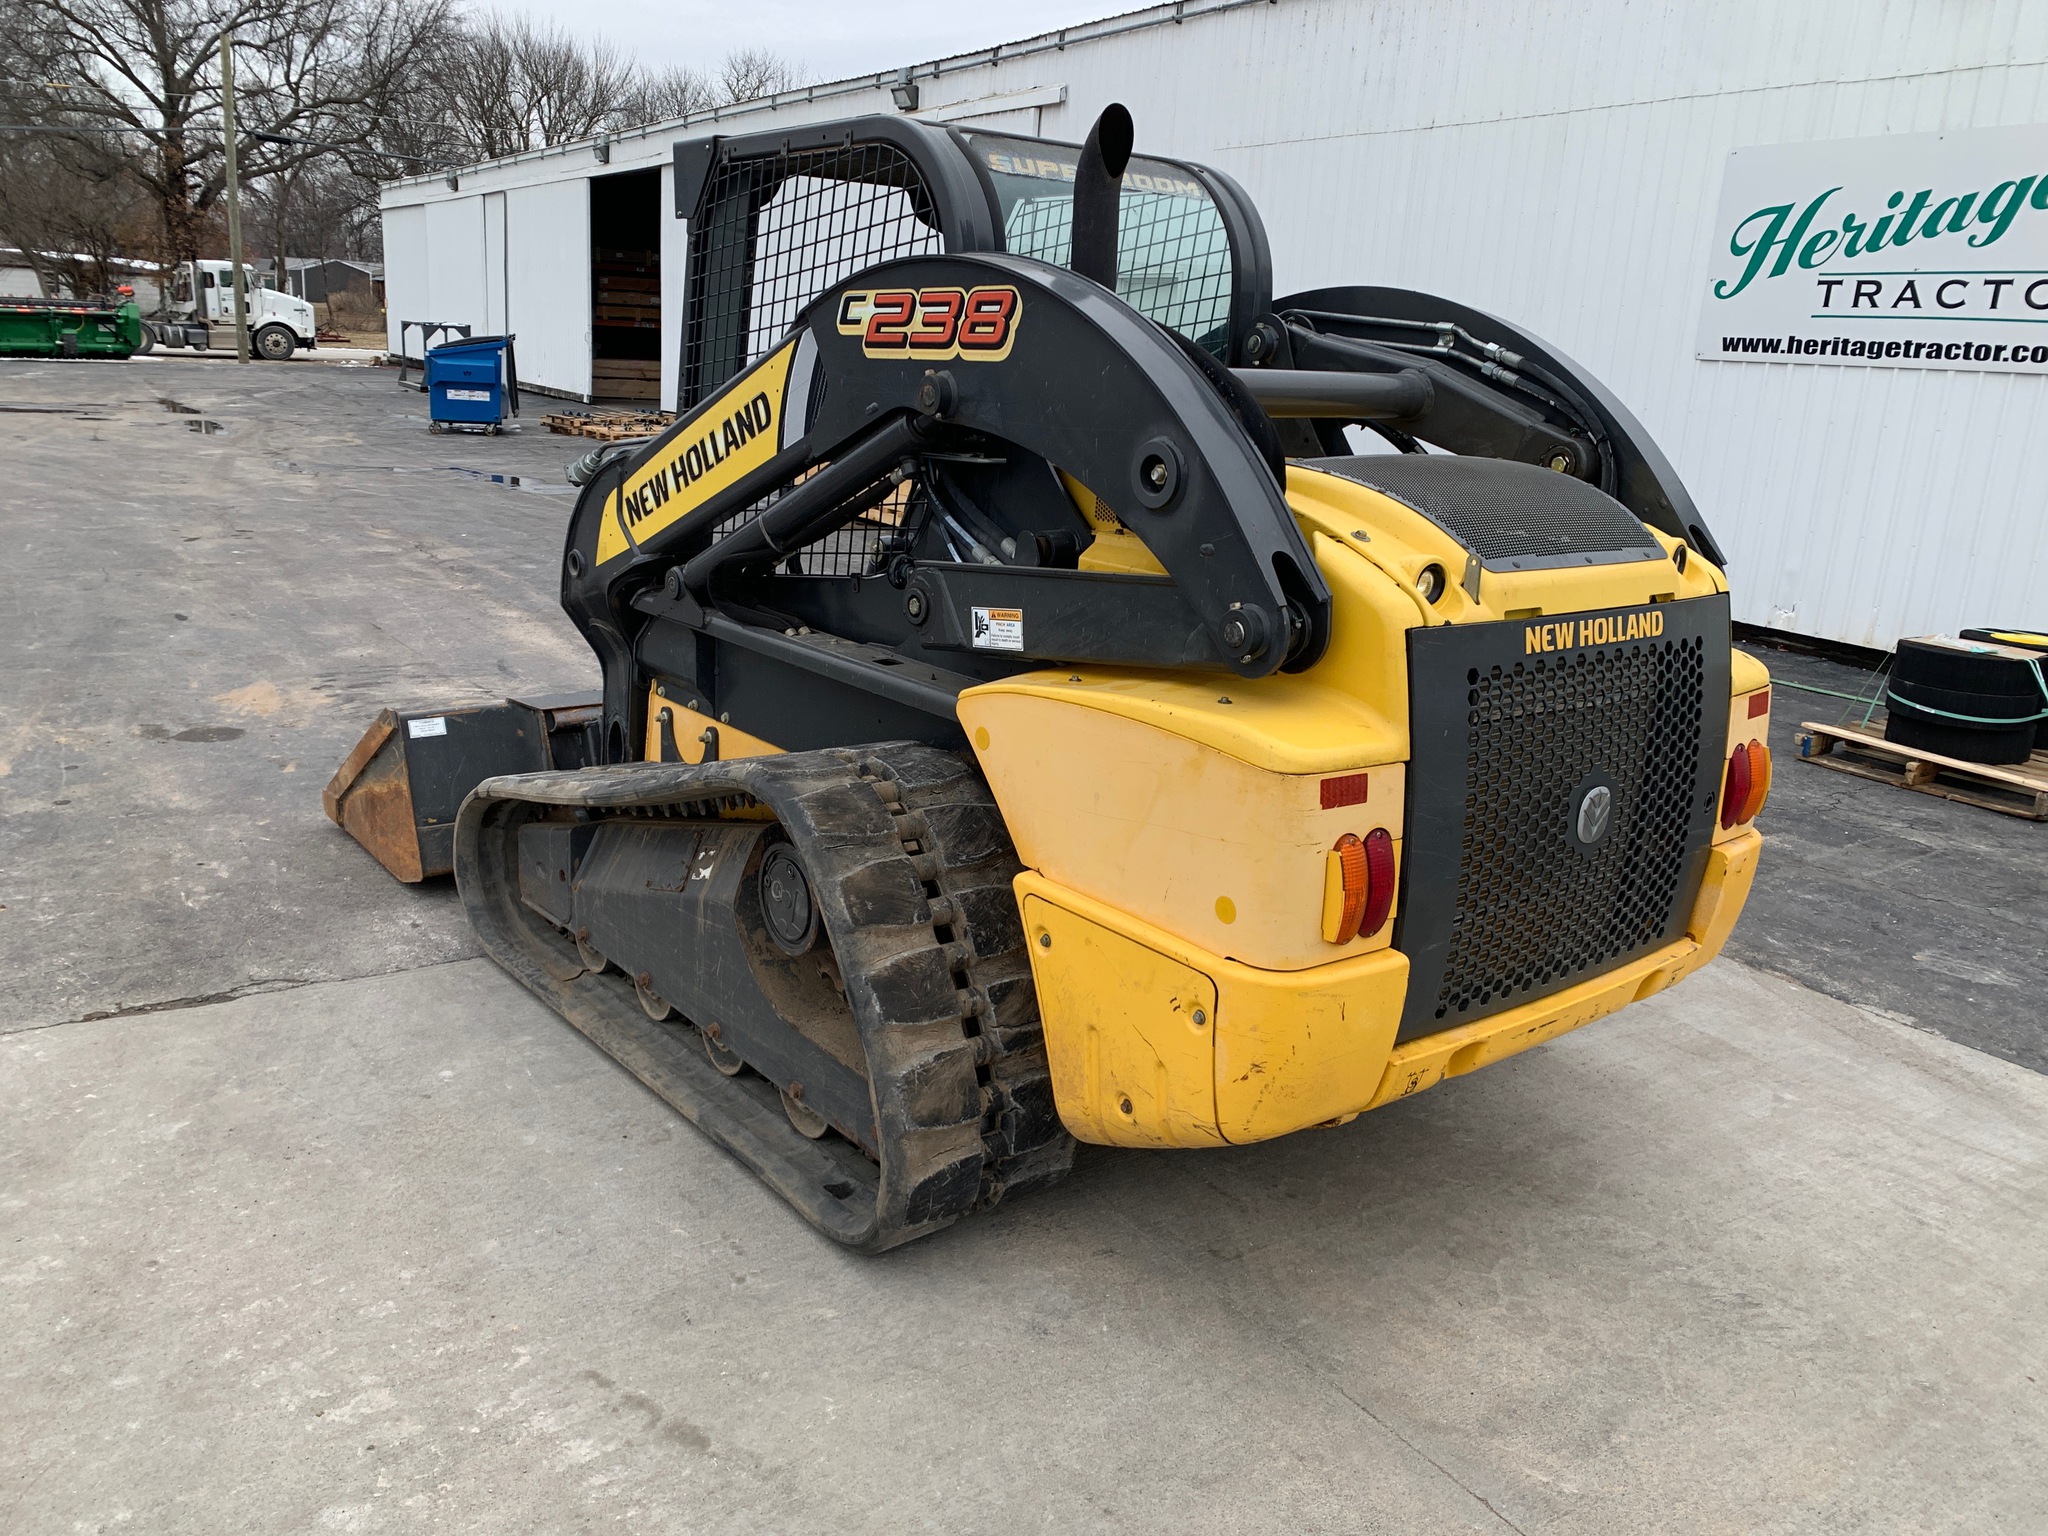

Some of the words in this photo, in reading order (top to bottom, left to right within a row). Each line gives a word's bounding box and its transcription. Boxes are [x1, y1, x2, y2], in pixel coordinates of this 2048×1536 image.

[838, 286, 1021, 360] C238
[1817, 278, 2048, 310] TRACTO
[625, 467, 670, 528] NEW
[670, 391, 772, 494] HOLLAND
[1525, 622, 1574, 655] NEW
[1579, 611, 1664, 647] HOLLAND
